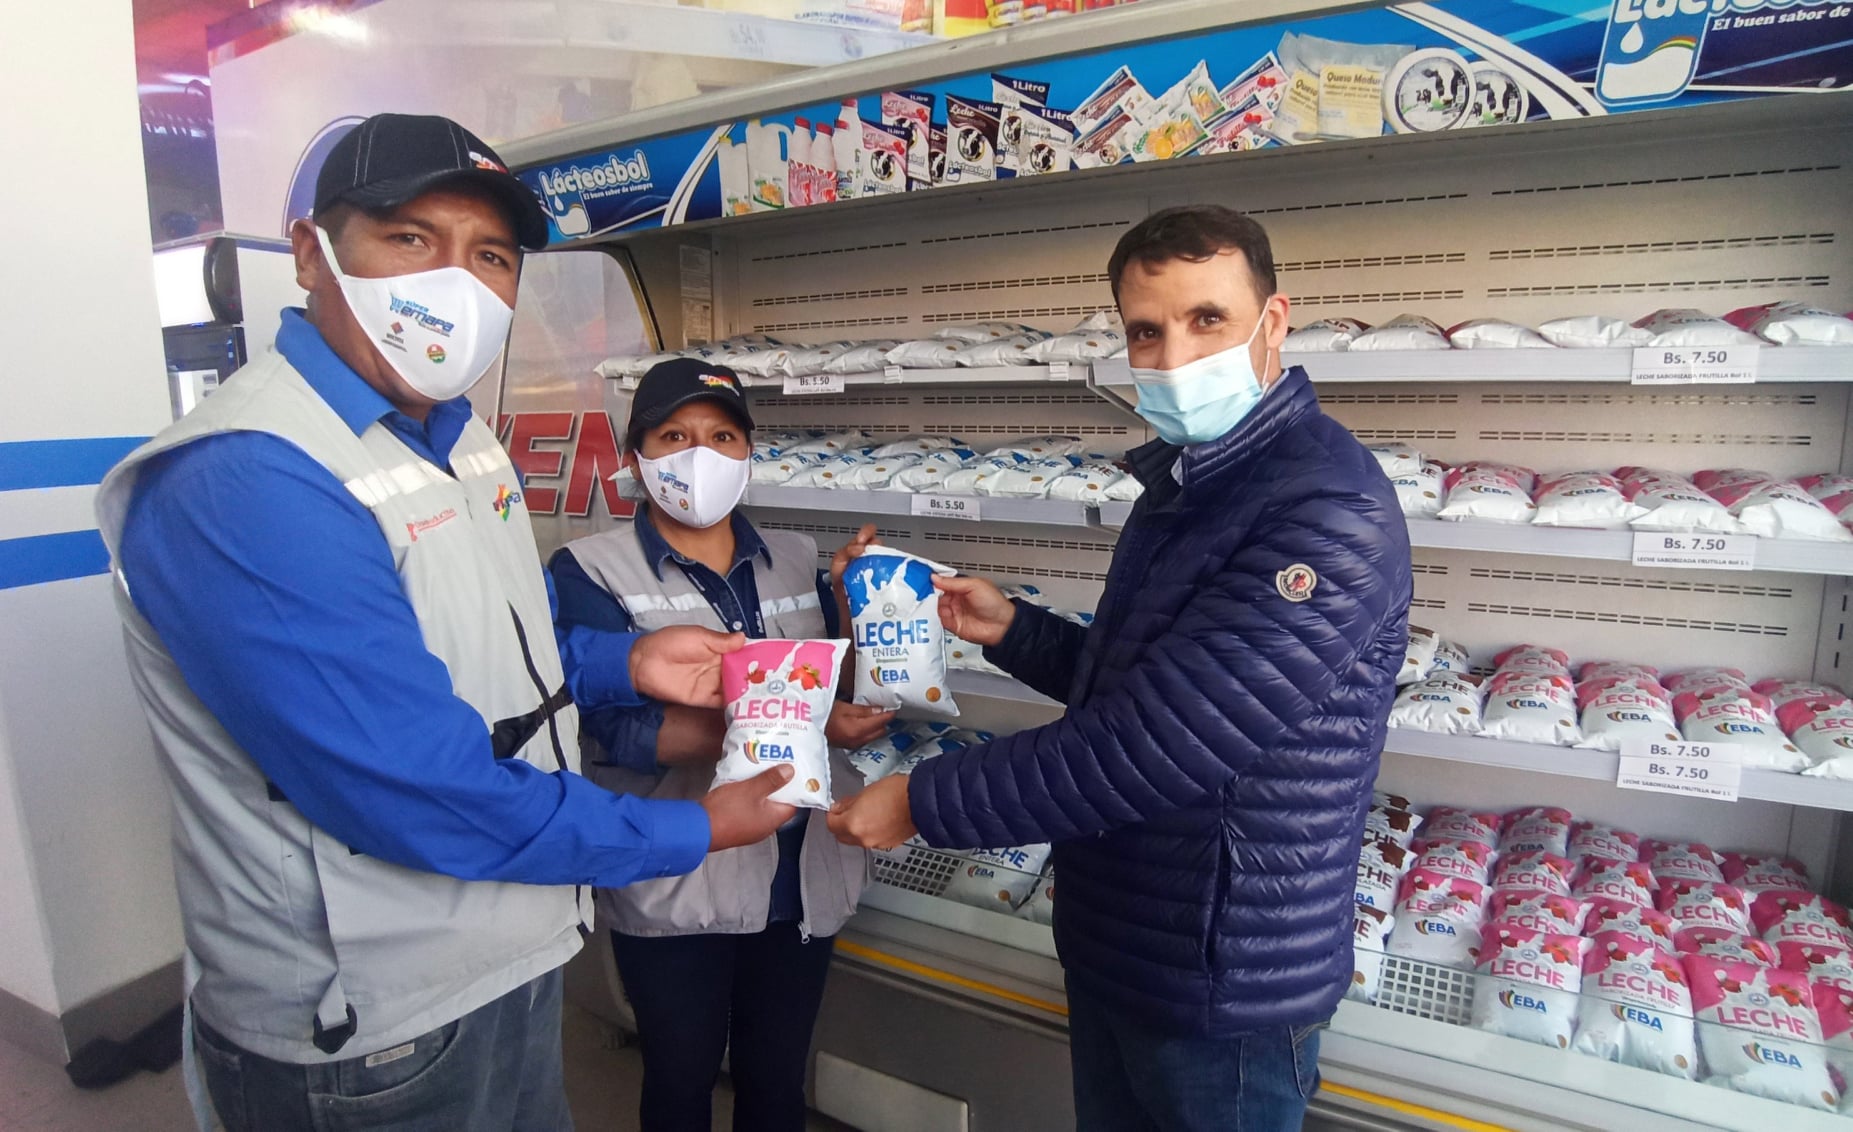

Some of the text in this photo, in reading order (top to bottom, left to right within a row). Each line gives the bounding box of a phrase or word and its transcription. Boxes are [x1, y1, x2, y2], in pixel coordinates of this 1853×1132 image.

[1711, 5, 1851, 32] El buen sabor de
[1353, 73, 1381, 85] Madur
[1663, 350, 1728, 364] Bs. 7.50
[1483, 486, 1513, 496] EBA
[930, 499, 965, 510] Bs. 5.50
[1663, 537, 1726, 551] Bs. 7.50
[855, 618, 930, 648] LECHE
[872, 646, 910, 657] ENTERA
[882, 669, 910, 682] EBA
[1424, 680, 1470, 696] CHE
[1499, 683, 1560, 704] LECHE
[1520, 700, 1548, 710] EBA
[1595, 693, 1658, 709] LECHE
[733, 698, 813, 722] LECHE
[1621, 712, 1652, 723] EBA
[1730, 724, 1765, 735] EBA
[1810, 718, 1853, 732] LEC
[759, 744, 794, 760] EBA
[1650, 744, 1711, 758] Bs. 7.50
[1648, 763, 1709, 780] Bs. 7.50
[1363, 828, 1399, 845] CHE
[1430, 819, 1485, 838] LECHE
[1573, 836, 1631, 857] LECHE
[1416, 855, 1475, 877] LECHE
[1652, 858, 1713, 878] LECHE
[1357, 863, 1394, 889] CHE
[1497, 872, 1558, 892] LECHE
[1355, 892, 1375, 906] BA
[1405, 899, 1468, 917] LECHE
[1427, 922, 1457, 937] EBA
[1505, 914, 1560, 934] ECHE
[1490, 959, 1565, 991] LECHE
[1598, 972, 1682, 1007] LECHE
[1513, 994, 1548, 1014] EBA
[1626, 1008, 1664, 1032] EBA
[1717, 1006, 1810, 1039] LECHE
[1761, 1047, 1803, 1069] EBA
